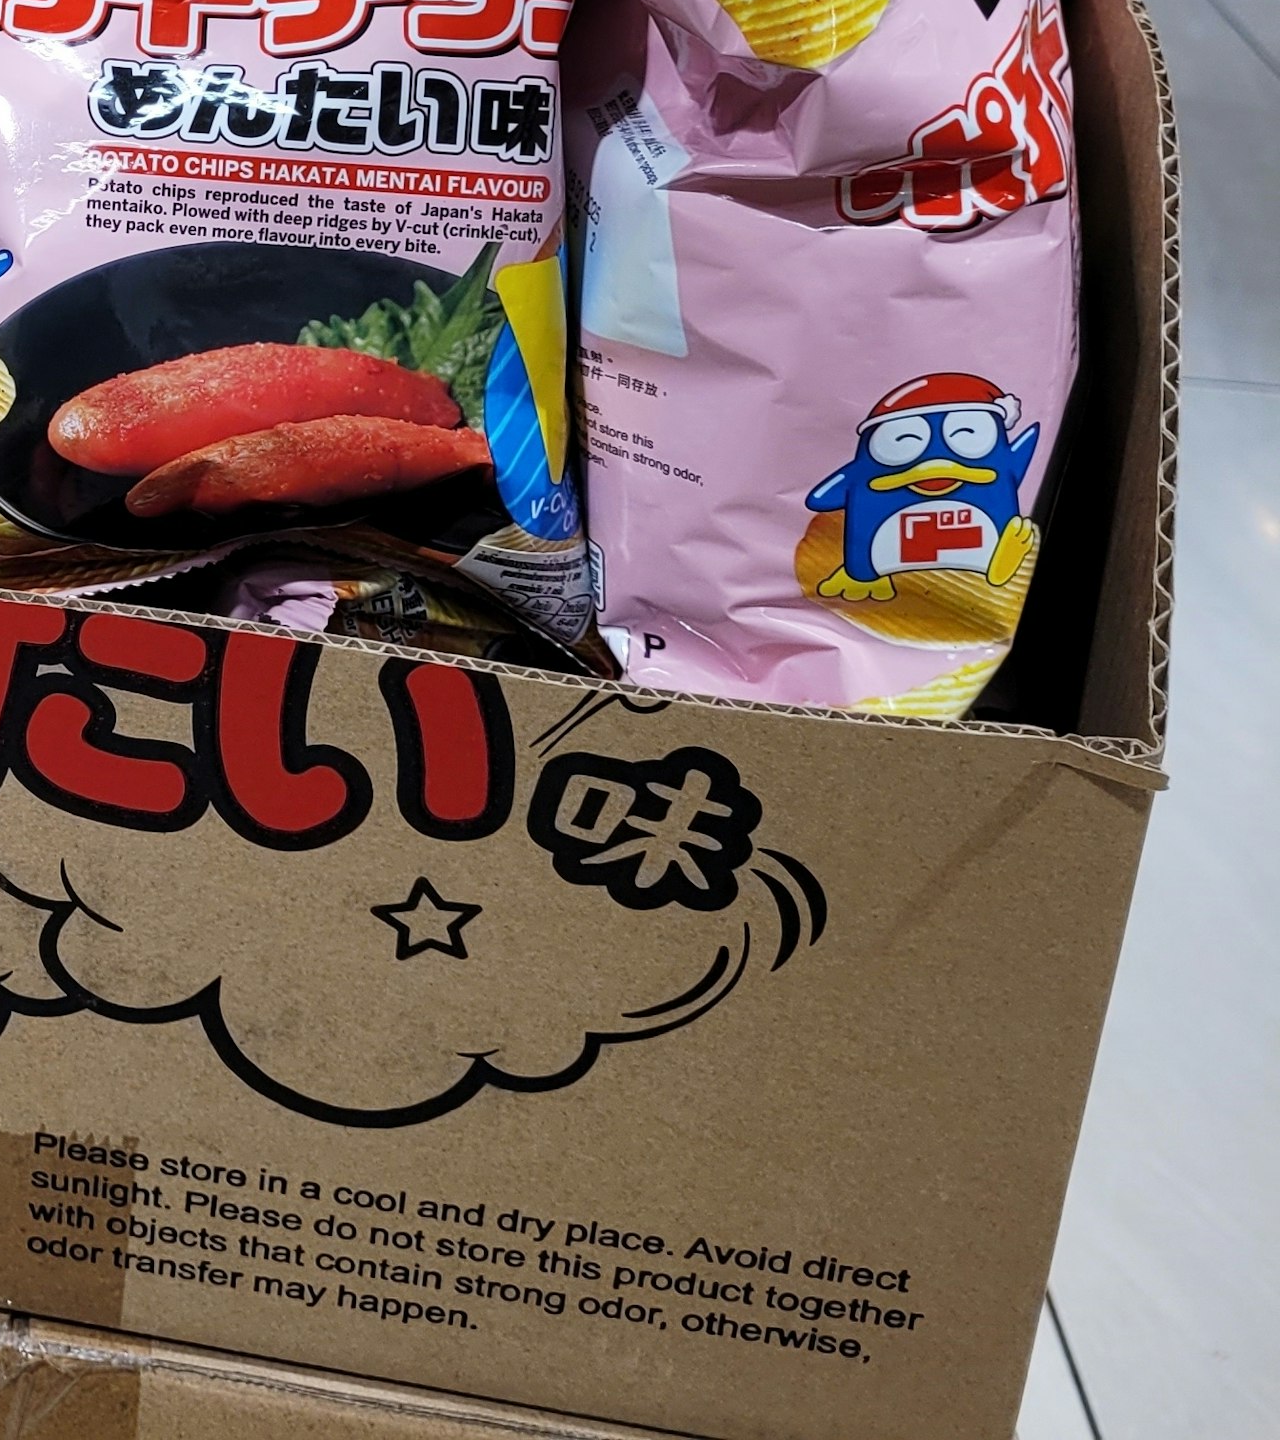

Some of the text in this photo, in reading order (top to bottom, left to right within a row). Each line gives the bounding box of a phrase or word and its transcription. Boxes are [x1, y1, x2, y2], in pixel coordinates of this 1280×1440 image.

[88, 60, 555, 165] めんたい味
[598, 423, 655, 450] store this
[30, 1170, 925, 1331] sunlight. Please do not store this product together
[33, 1131, 912, 1294] Please store in a cool and dry place. Avoid direct
[26, 1236, 478, 1331] odor transfer may happen.
[28, 1202, 871, 1365] with objects that contain strong odor, otherwise,
